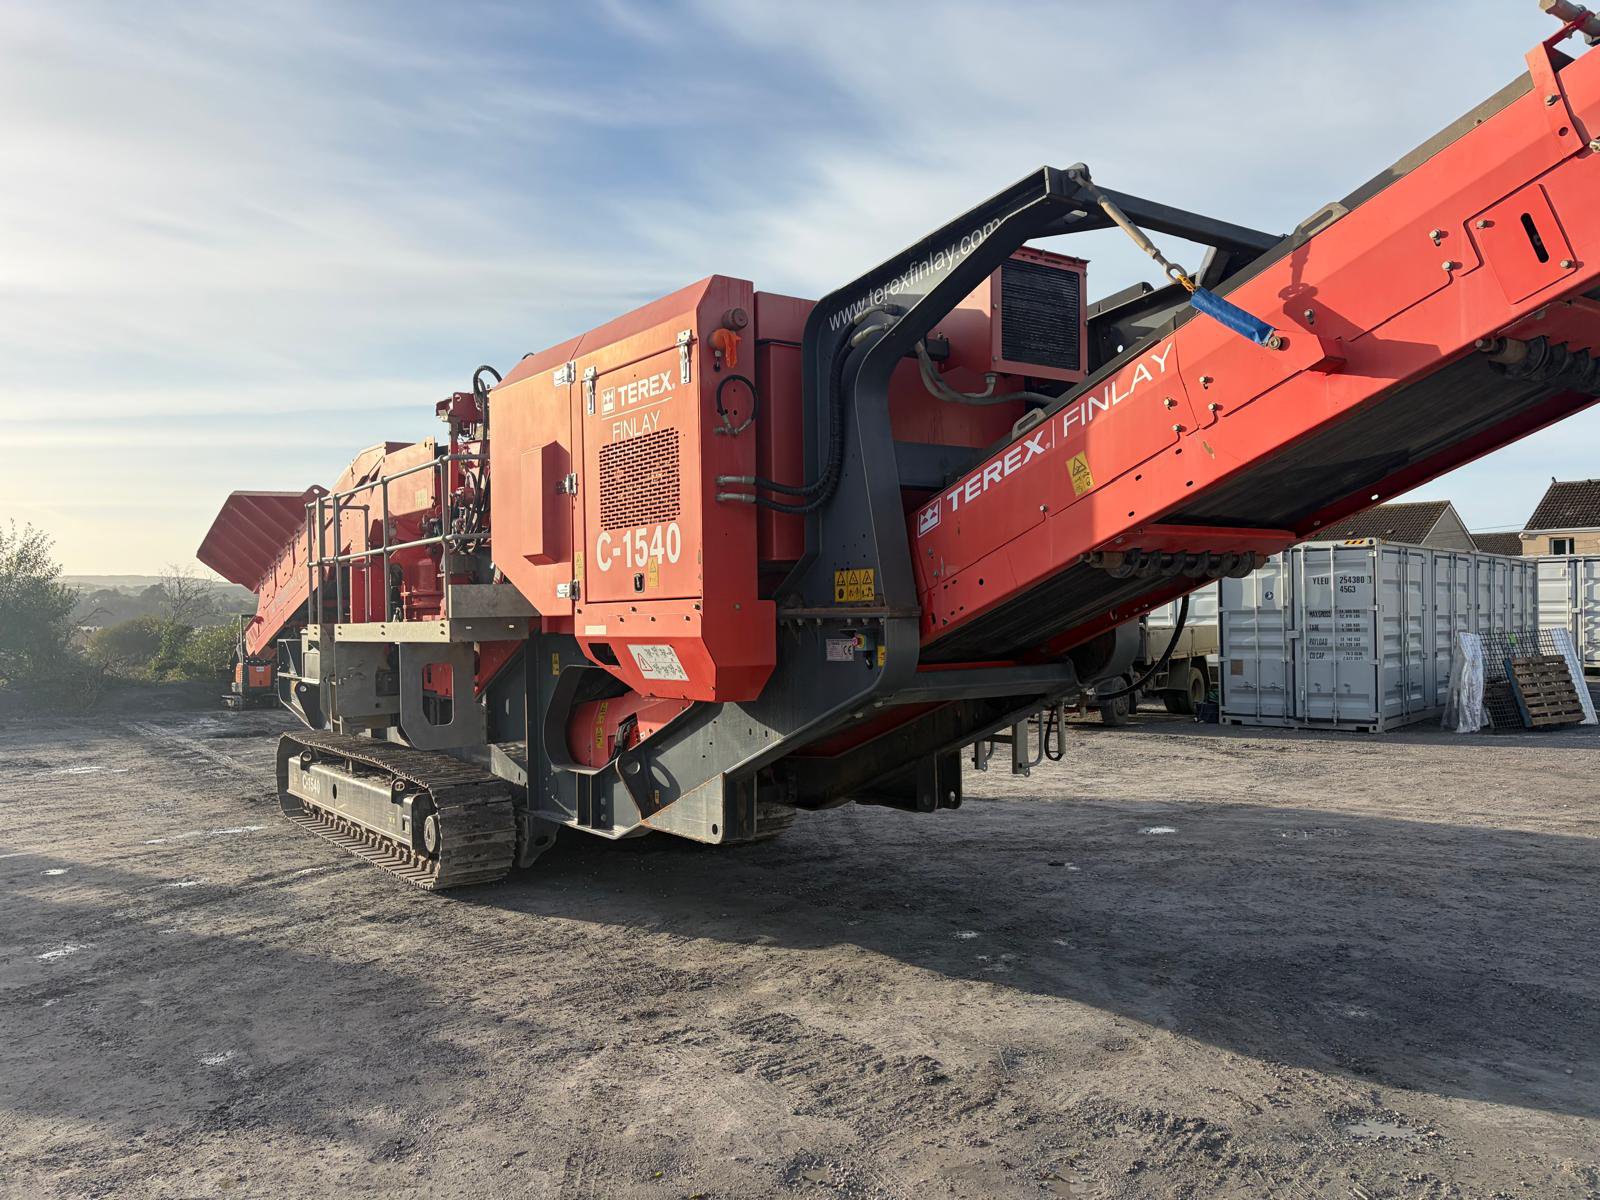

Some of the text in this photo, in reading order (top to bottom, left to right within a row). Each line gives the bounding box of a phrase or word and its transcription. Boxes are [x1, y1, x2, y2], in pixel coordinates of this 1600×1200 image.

[828, 217, 1000, 332] wwwterexfinlay.com
[618, 369, 673, 407] TEREX
[612, 410, 661, 443] FINLAY
[947, 342, 1173, 512] TEREX FINLAY
[596, 522, 681, 572] C-1540
